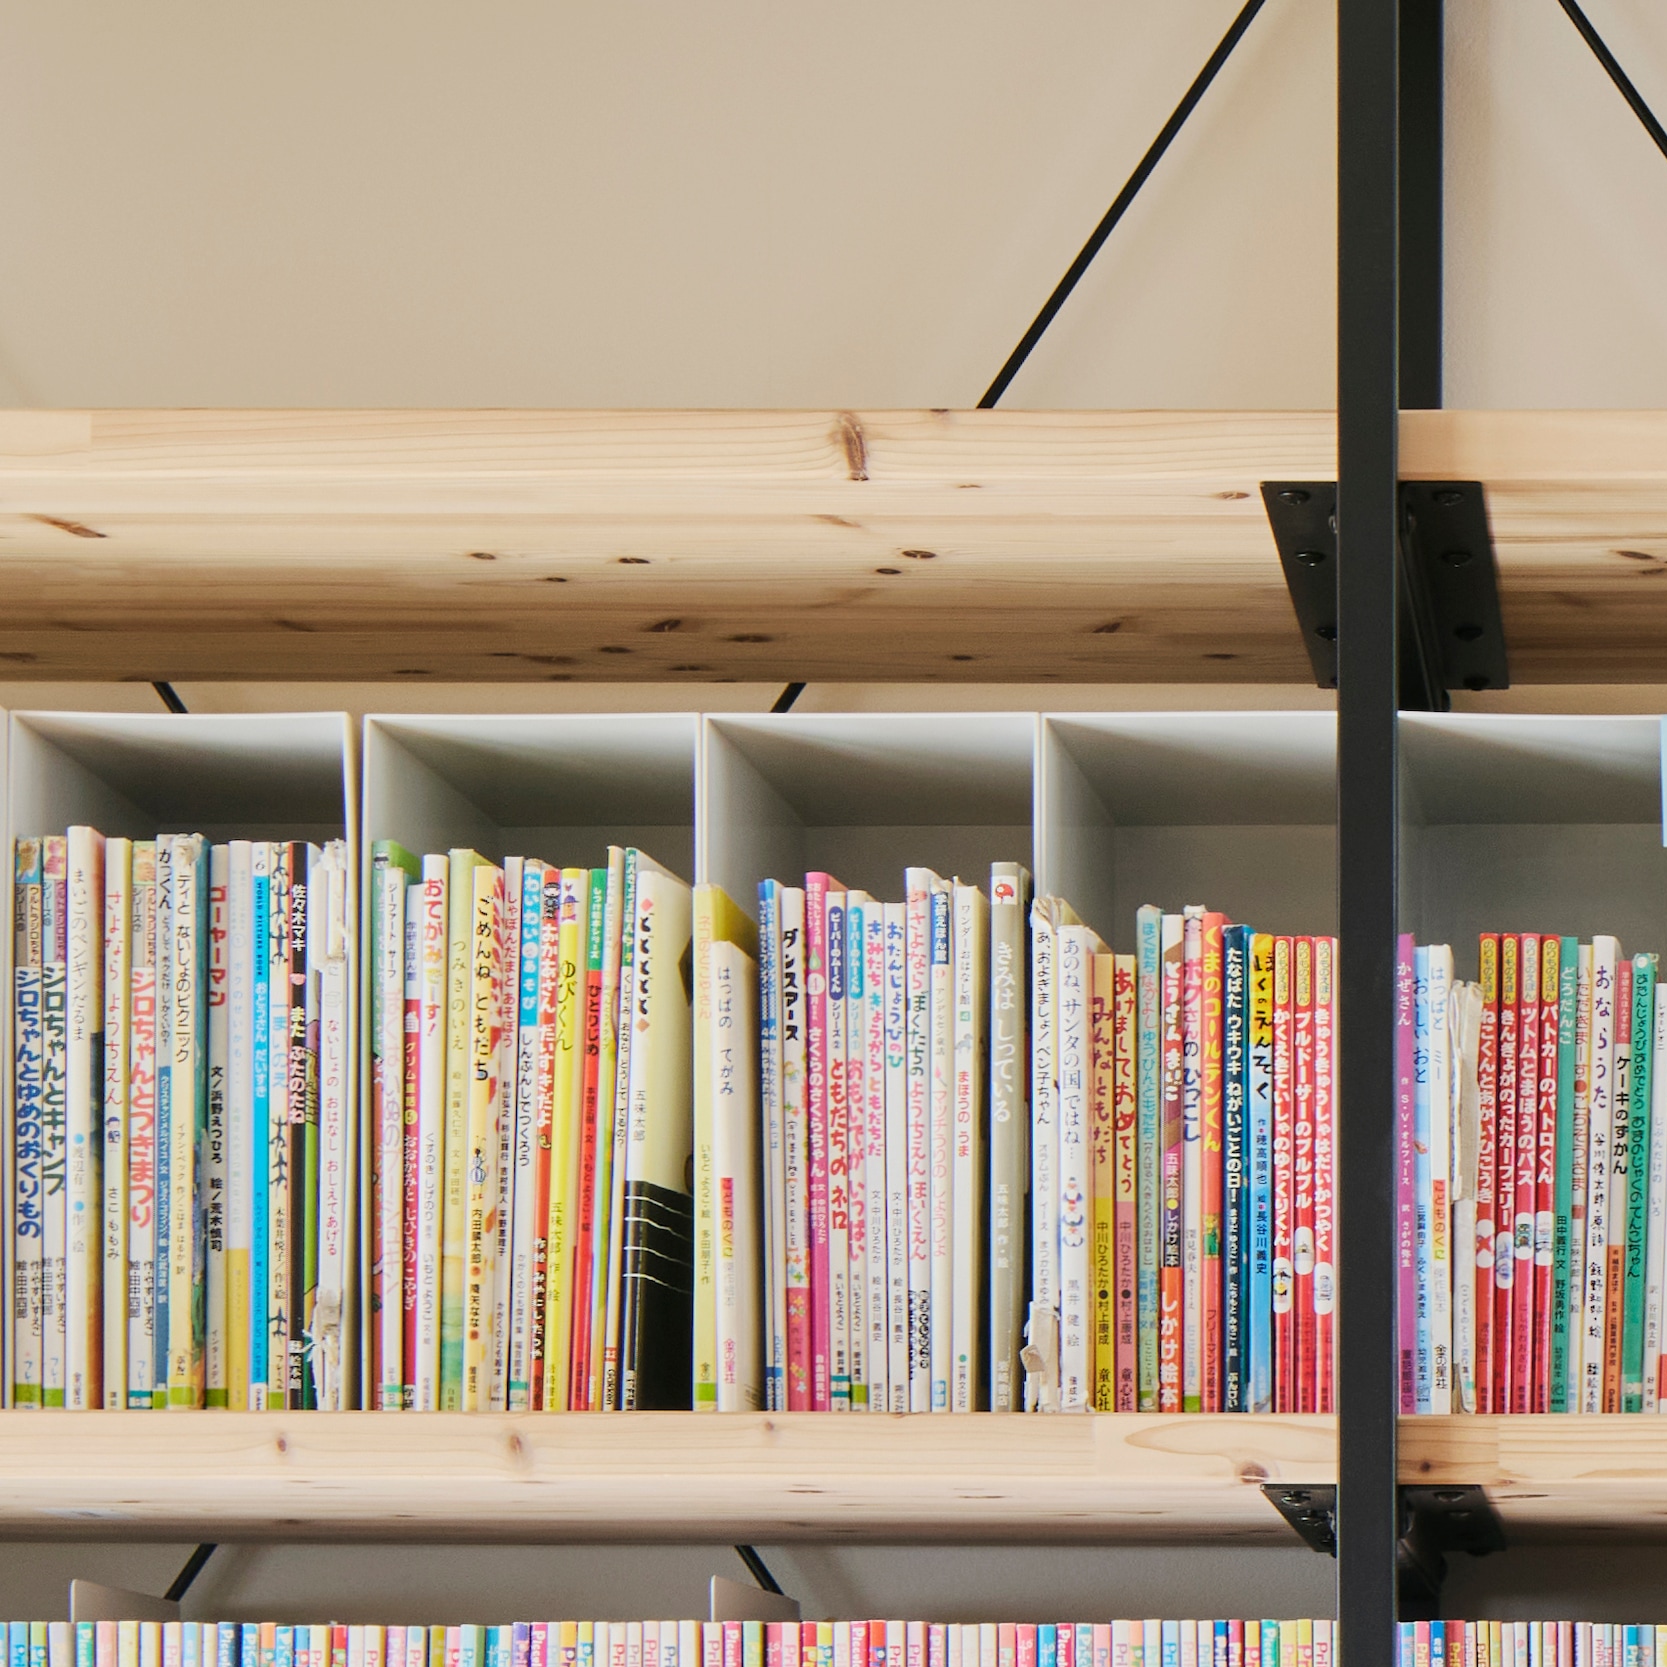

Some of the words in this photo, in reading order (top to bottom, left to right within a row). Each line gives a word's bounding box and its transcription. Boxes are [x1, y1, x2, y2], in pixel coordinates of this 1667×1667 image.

[209, 886, 226, 1007] ゴーヤーマン
[474, 896, 492, 980] ごめんね
[867, 920, 883, 988] きみたち
[908, 912, 926, 989] さよなら
[1226, 947, 1243, 1009] たなばた
[555, 959, 577, 1051] ゆびくん
[717, 966, 733, 1029] はっぱの
[783, 928, 799, 1041] ダンスアース
[1164, 961, 1182, 1041] とうさん
[1397, 961, 1412, 1027] かぜさん
[106, 994, 123, 1105] ようちえん
[473, 993, 491, 1080] ともだち
[994, 1019, 1016, 1123] しっている
[1226, 1014, 1243, 1075] ウキウキ
[1414, 1046, 1428, 1084] おと
[1594, 965, 1613, 1110] おならうた
[829, 1058, 847, 1176] ともだちの
[868, 1078, 884, 1157] ともだちだ
[909, 1083, 926, 1176] ようちえん
[957, 1071, 971, 1123] まほうの
[1516, 1006, 1537, 1185] ツトムとまほうのバス
[1612, 1056, 1632, 1175] ケーキのずかん
[830, 1186, 847, 1230] ネロ
[848, 1181, 865, 1261] いっぱい
[909, 1181, 927, 1261] ほいくえん
[1161, 1291, 1179, 1407] しかけ絵本
[1096, 1368, 1111, 1411] 童心社
